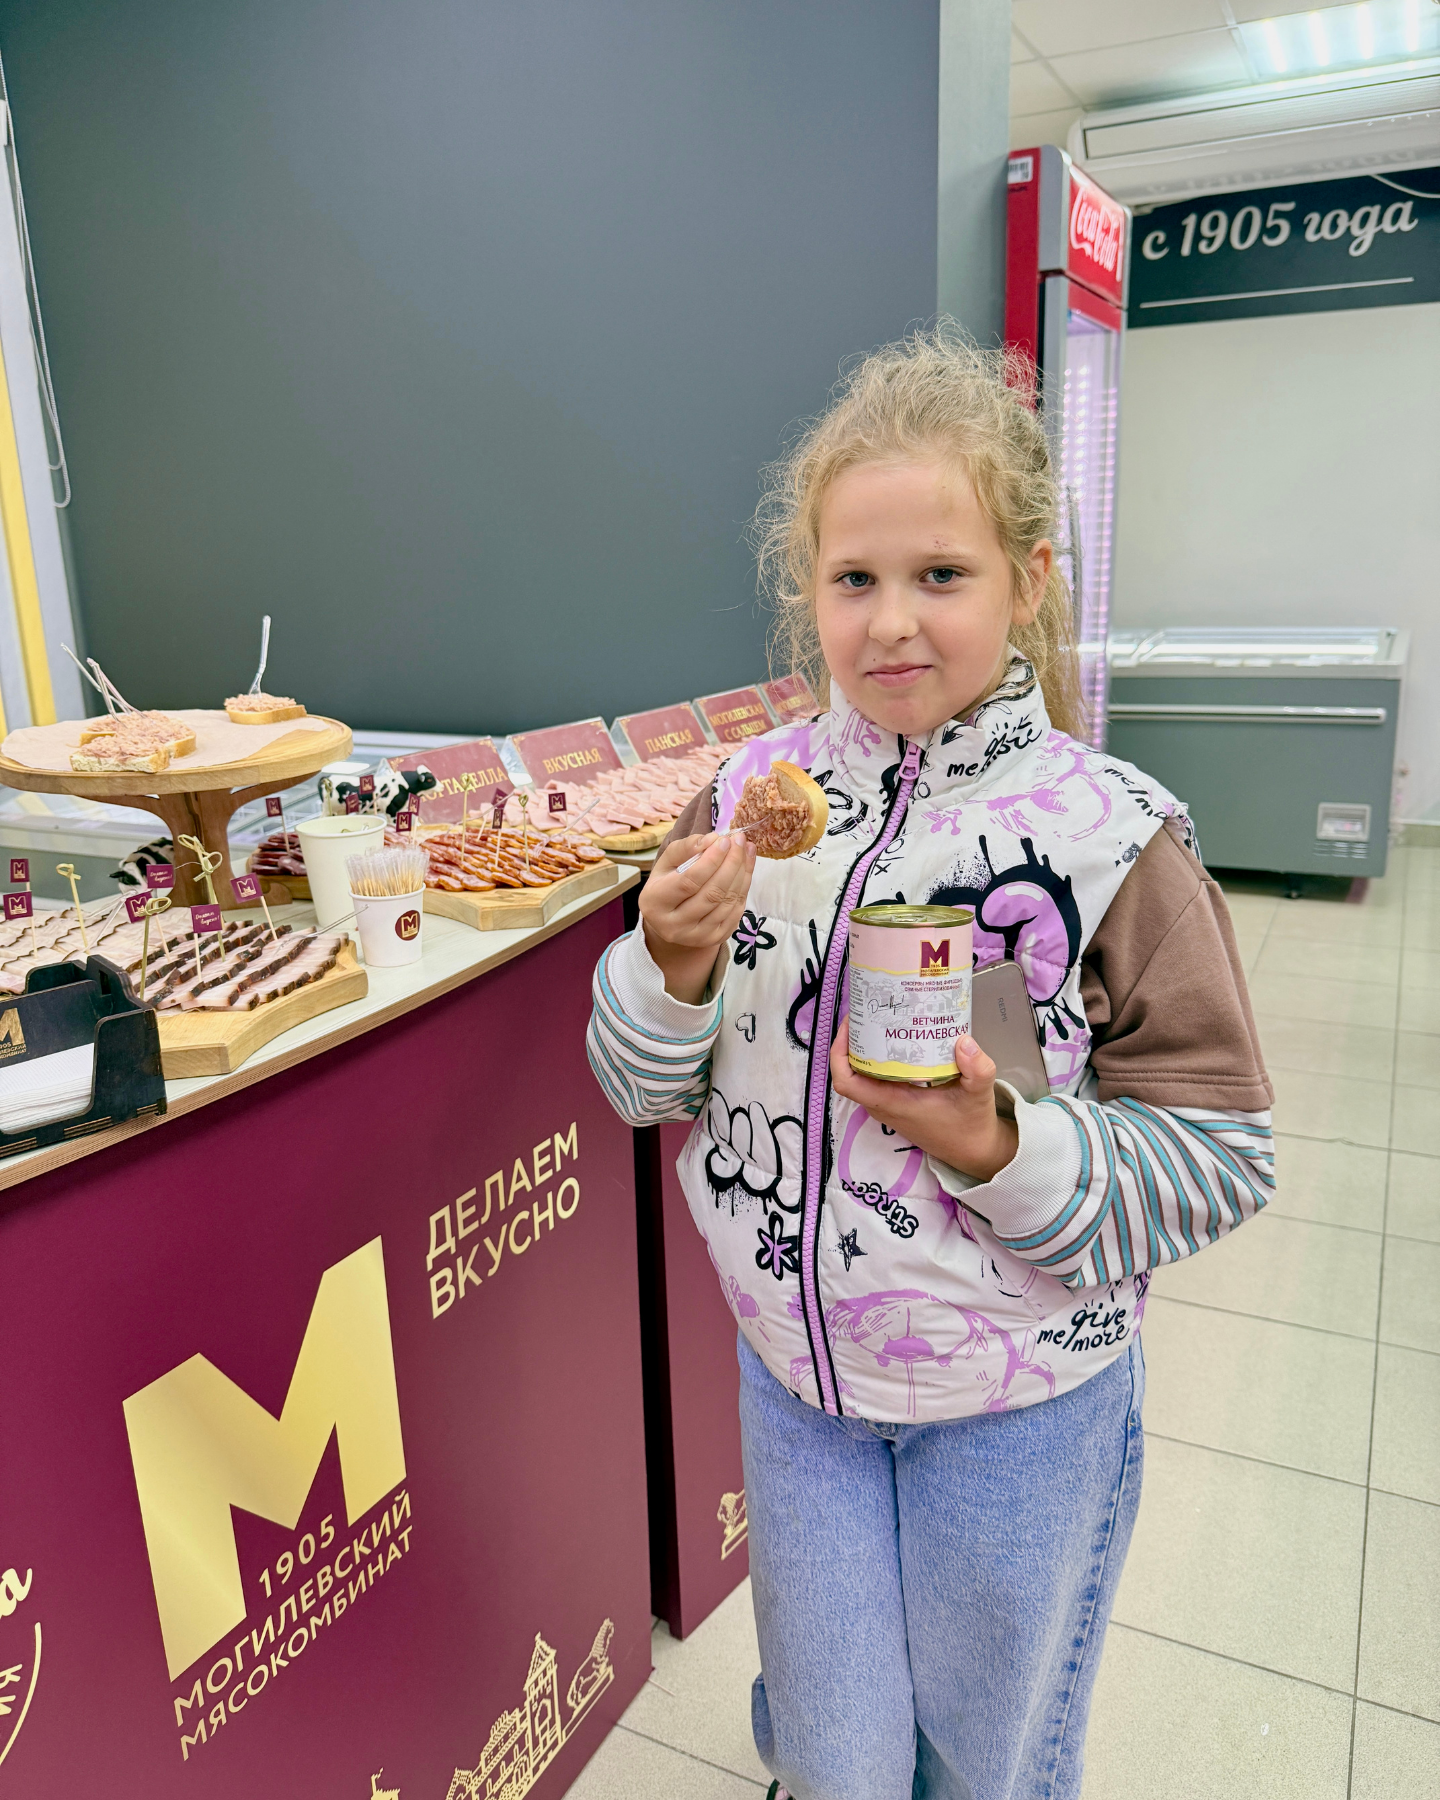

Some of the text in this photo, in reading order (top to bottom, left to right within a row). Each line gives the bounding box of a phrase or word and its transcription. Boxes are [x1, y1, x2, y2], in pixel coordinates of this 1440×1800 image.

[1180, 201, 1296, 257] 1905
[1303, 200, 1418, 257] года
[542, 747, 603, 775] ВКУСНАЯ
[644, 728, 695, 754] ПАНСКАЯ
[885, 1022, 969, 1040] МОГИЛЕВСКАЯ
[912, 1015, 955, 1026] ВЕТЧИНА
[997, 997, 1008, 1023] REDMI
[426, 1121, 578, 1272] ДЕЛАЕМ
[429, 1177, 580, 1320] ВКУСНО
[1037, 1324, 1130, 1352] me more
[1063, 1302, 1127, 1349] give
[258, 1513, 335, 1598] 1905
[173, 1488, 412, 1727] МОГИЛЕВСКИЙ
[180, 1525, 413, 1762] МЯСОКОМБИНАТ
